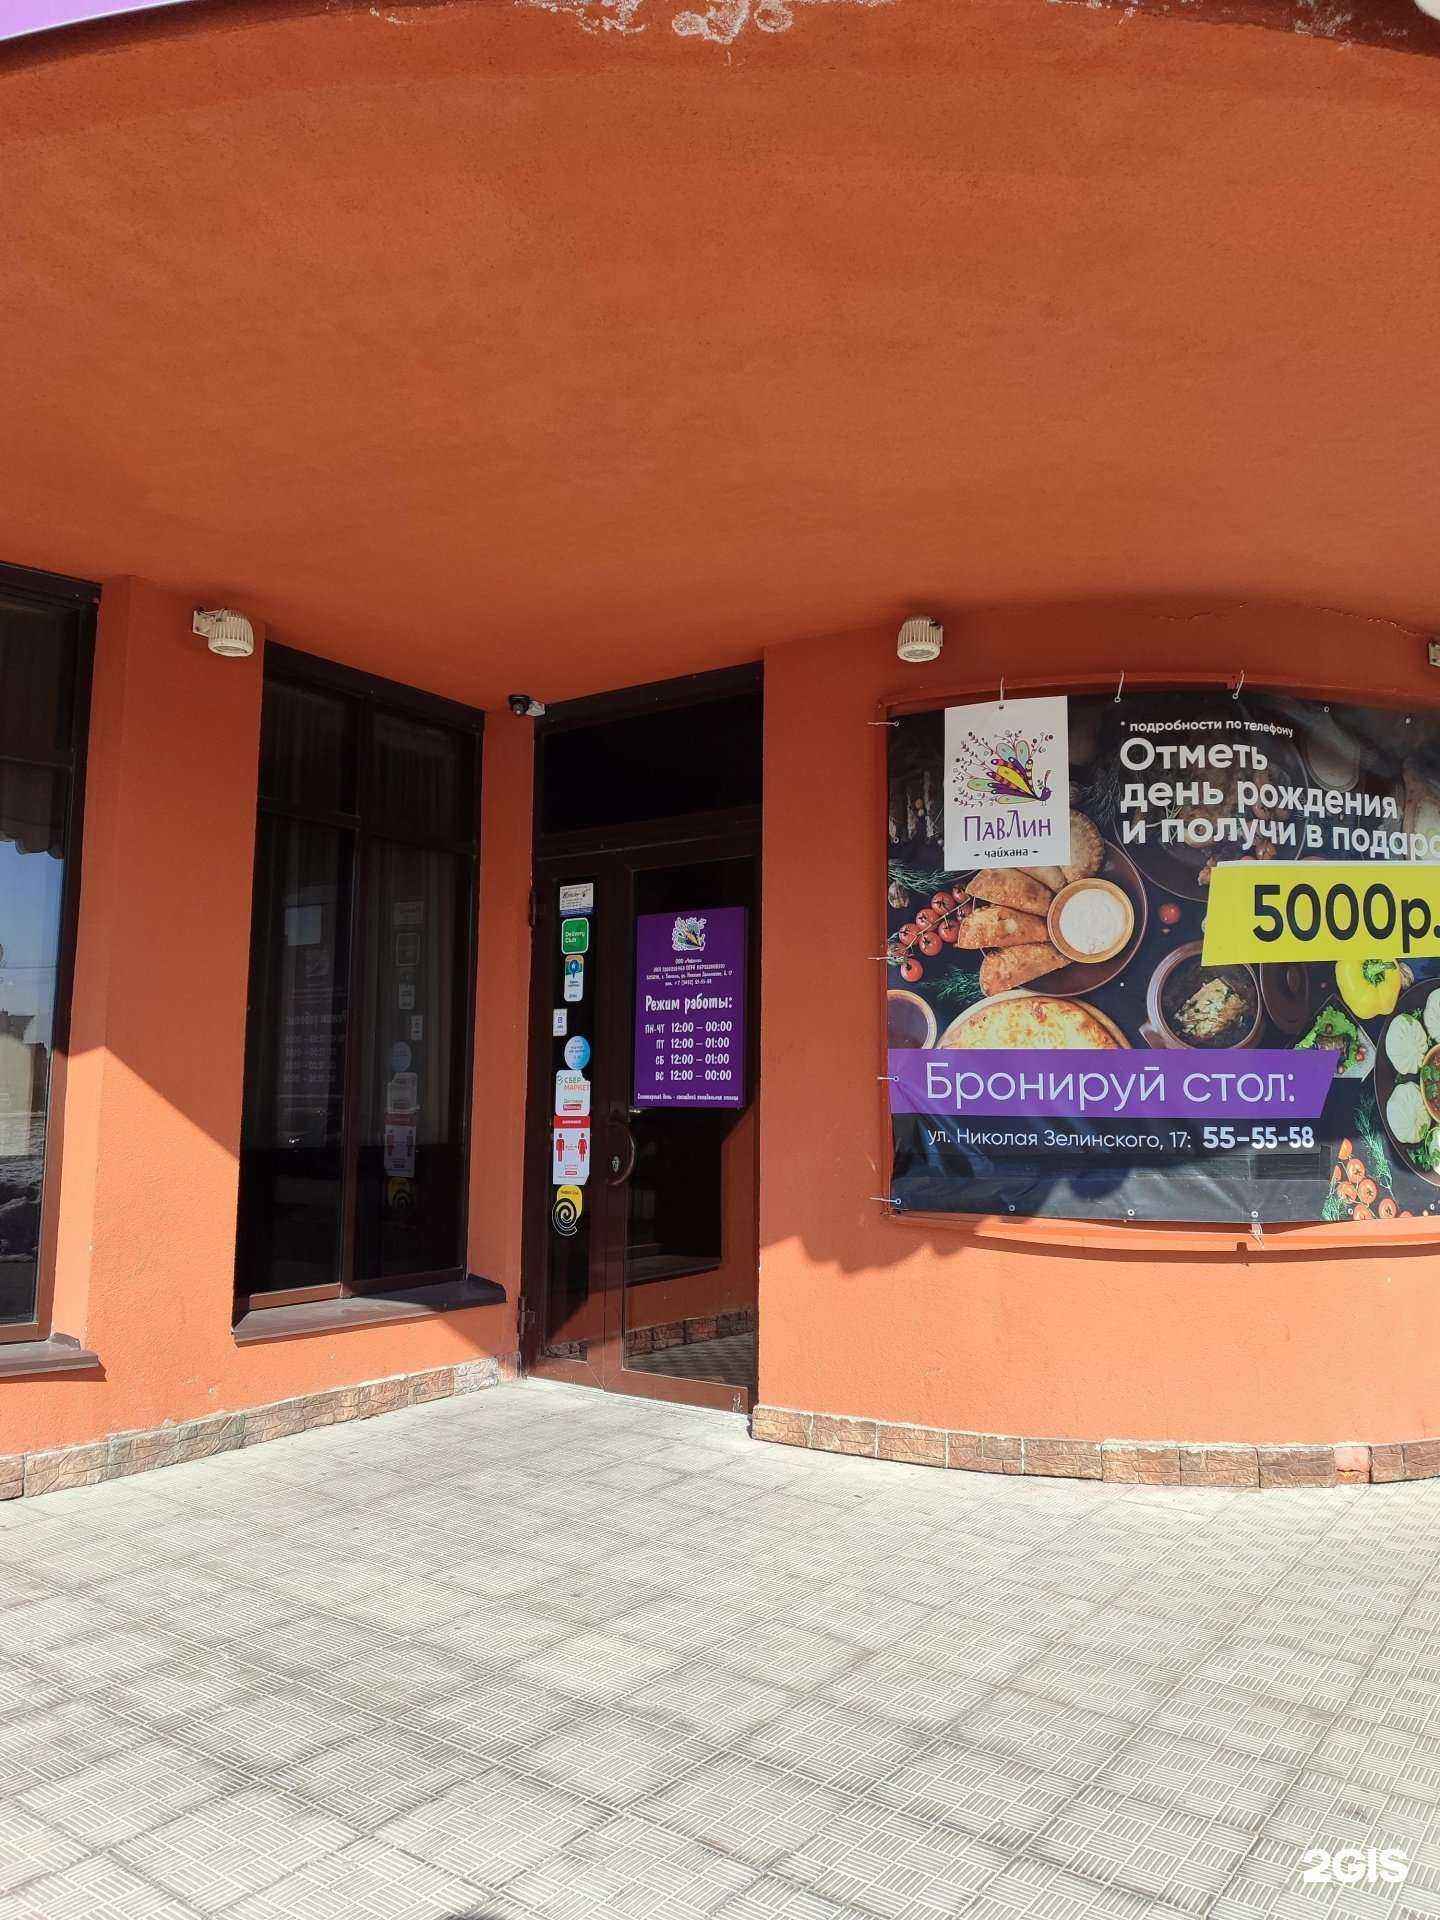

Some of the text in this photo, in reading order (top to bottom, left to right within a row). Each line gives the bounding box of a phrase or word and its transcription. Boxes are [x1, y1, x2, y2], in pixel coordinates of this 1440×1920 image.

[1130, 720, 1293, 737] подробности по телефону
[1120, 737, 1268, 771] Отметь
[1120, 781, 1398, 820] день рождения
[1123, 819, 1146, 845] и
[1161, 818, 1297, 851] получи
[1306, 824, 1323, 849] в
[984, 846, 1029, 859] чайхана
[645, 993, 733, 1015] Режим работы:
[671, 1022, 694, 1033] 12:00
[705, 1021, 732, 1032] 00:00
[671, 1038, 694, 1049] 12:00
[705, 1037, 730, 1048] 01:00
[671, 1054, 693, 1065] 12:00
[705, 1053, 730, 1064] 01:00
[670, 1070, 693, 1081] 12:00
[705, 1070, 732, 1081] 00:00
[925, 1062, 1295, 1112] Бронируй стол:
[927, 1126, 1315, 1151] ул. Николая Зелинского, 17: 55-55-58
